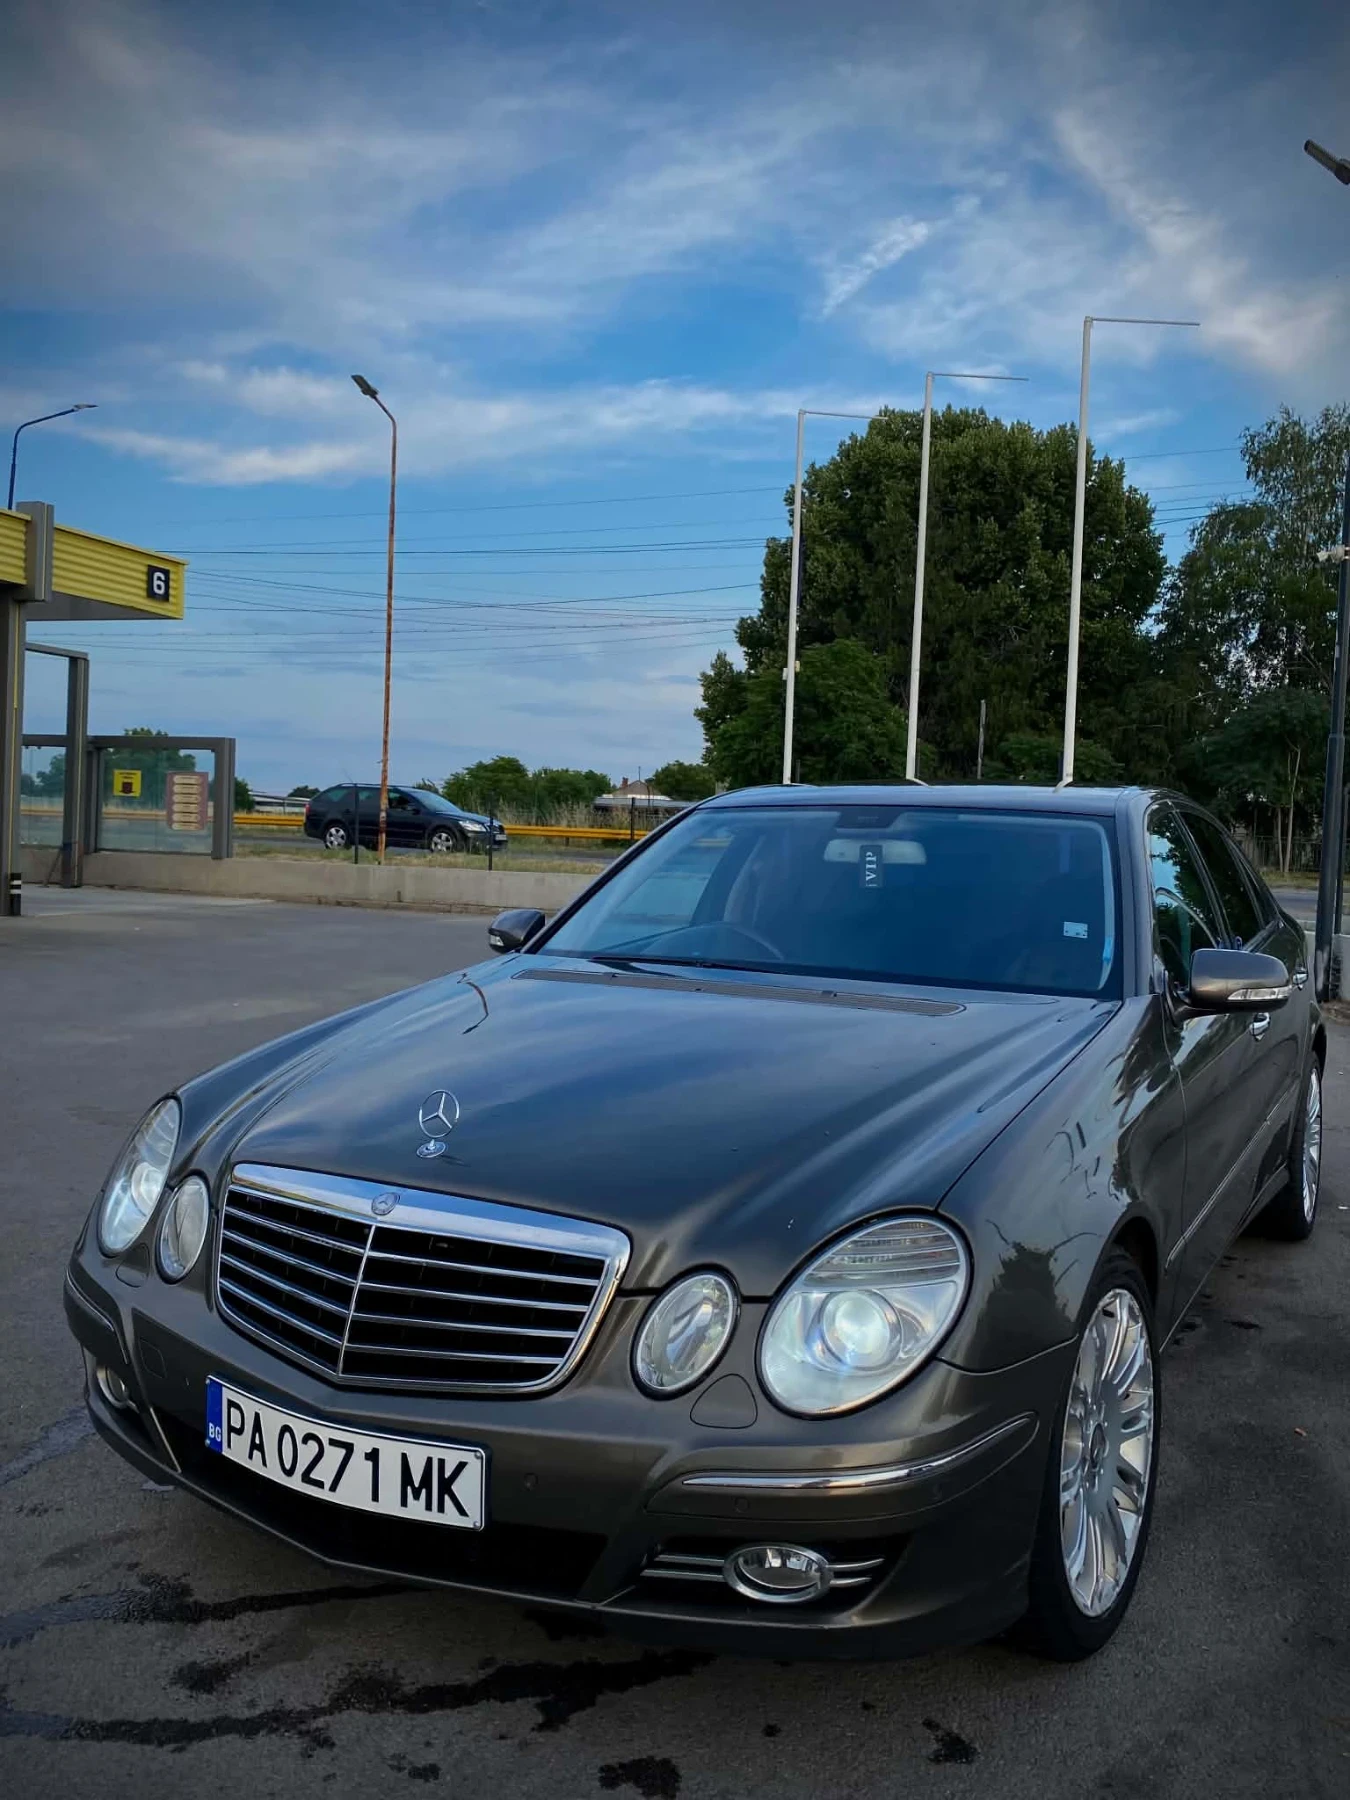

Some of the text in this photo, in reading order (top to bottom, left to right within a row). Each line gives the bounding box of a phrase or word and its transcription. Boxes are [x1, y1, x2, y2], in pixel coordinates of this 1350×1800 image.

[153, 571, 165, 595] 6
[865, 851, 877, 881] VIP
[208, 1422, 222, 1442] BG
[226, 1397, 470, 1518] PA 0271 MK
